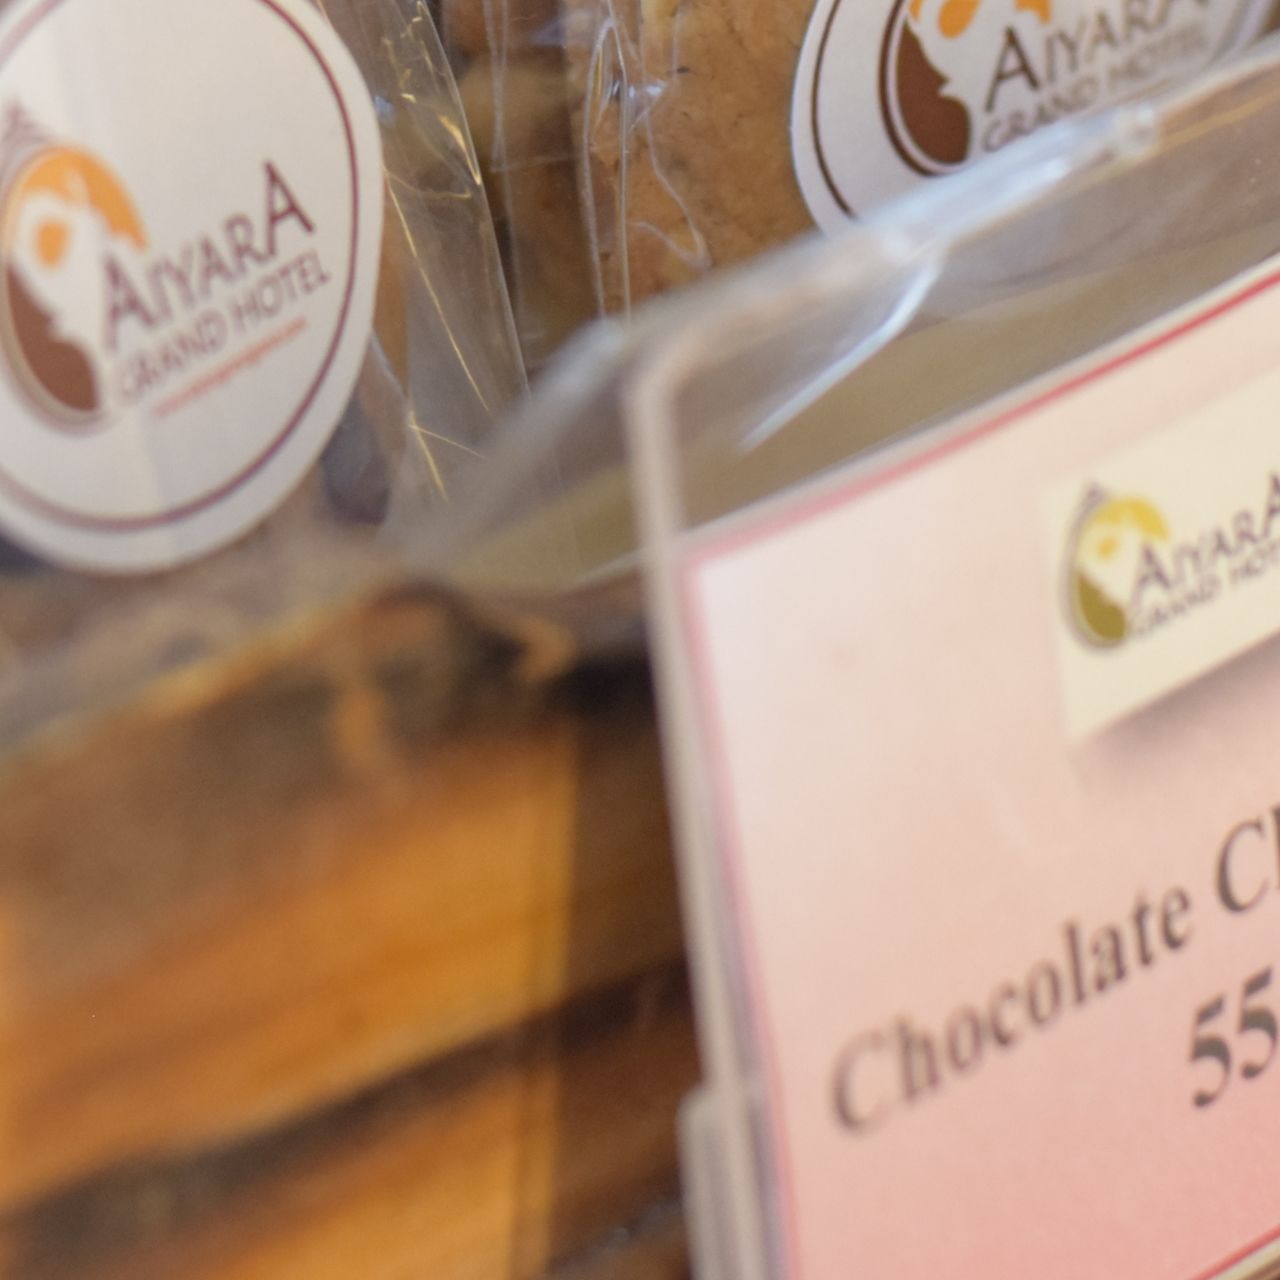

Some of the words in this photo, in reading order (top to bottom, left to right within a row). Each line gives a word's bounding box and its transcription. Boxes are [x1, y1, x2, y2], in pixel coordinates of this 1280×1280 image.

[102, 159, 315, 353] AIYARA
[231, 249, 331, 333] HOTEL
[830, 883, 1192, 1132] Chocolate
